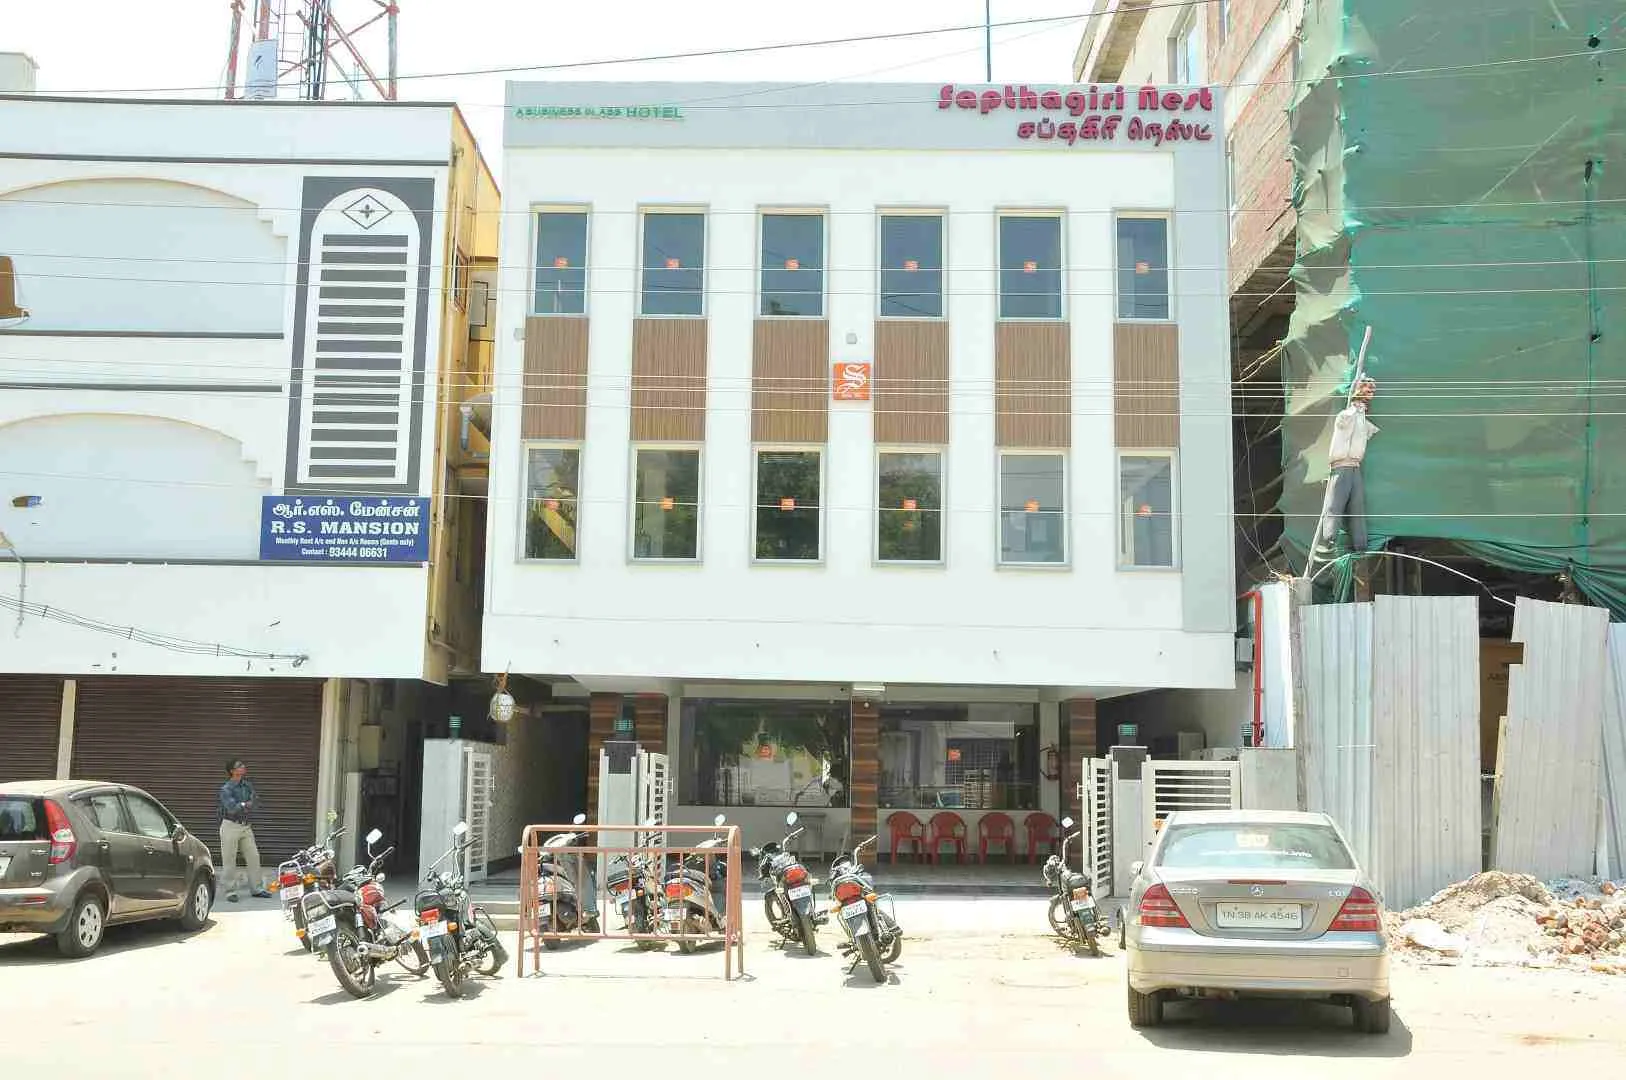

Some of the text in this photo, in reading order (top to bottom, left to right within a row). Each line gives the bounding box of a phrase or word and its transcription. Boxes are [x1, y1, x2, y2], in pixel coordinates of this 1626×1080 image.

[938, 84, 1213, 116] Sapthagiri Nest
[525, 106, 582, 117] BUSINESS
[626, 105, 684, 118] HOTEL
[1017, 115, 1122, 146] சப்தகிரி
[350, 499, 420, 517] மேன்சன்
[271, 520, 420, 535] R.S. MANSION
[275, 537, 299, 546] Monthly
[301, 547, 324, 555] Contact
[329, 547, 357, 557] 93444
[360, 547, 387, 558] 06631
